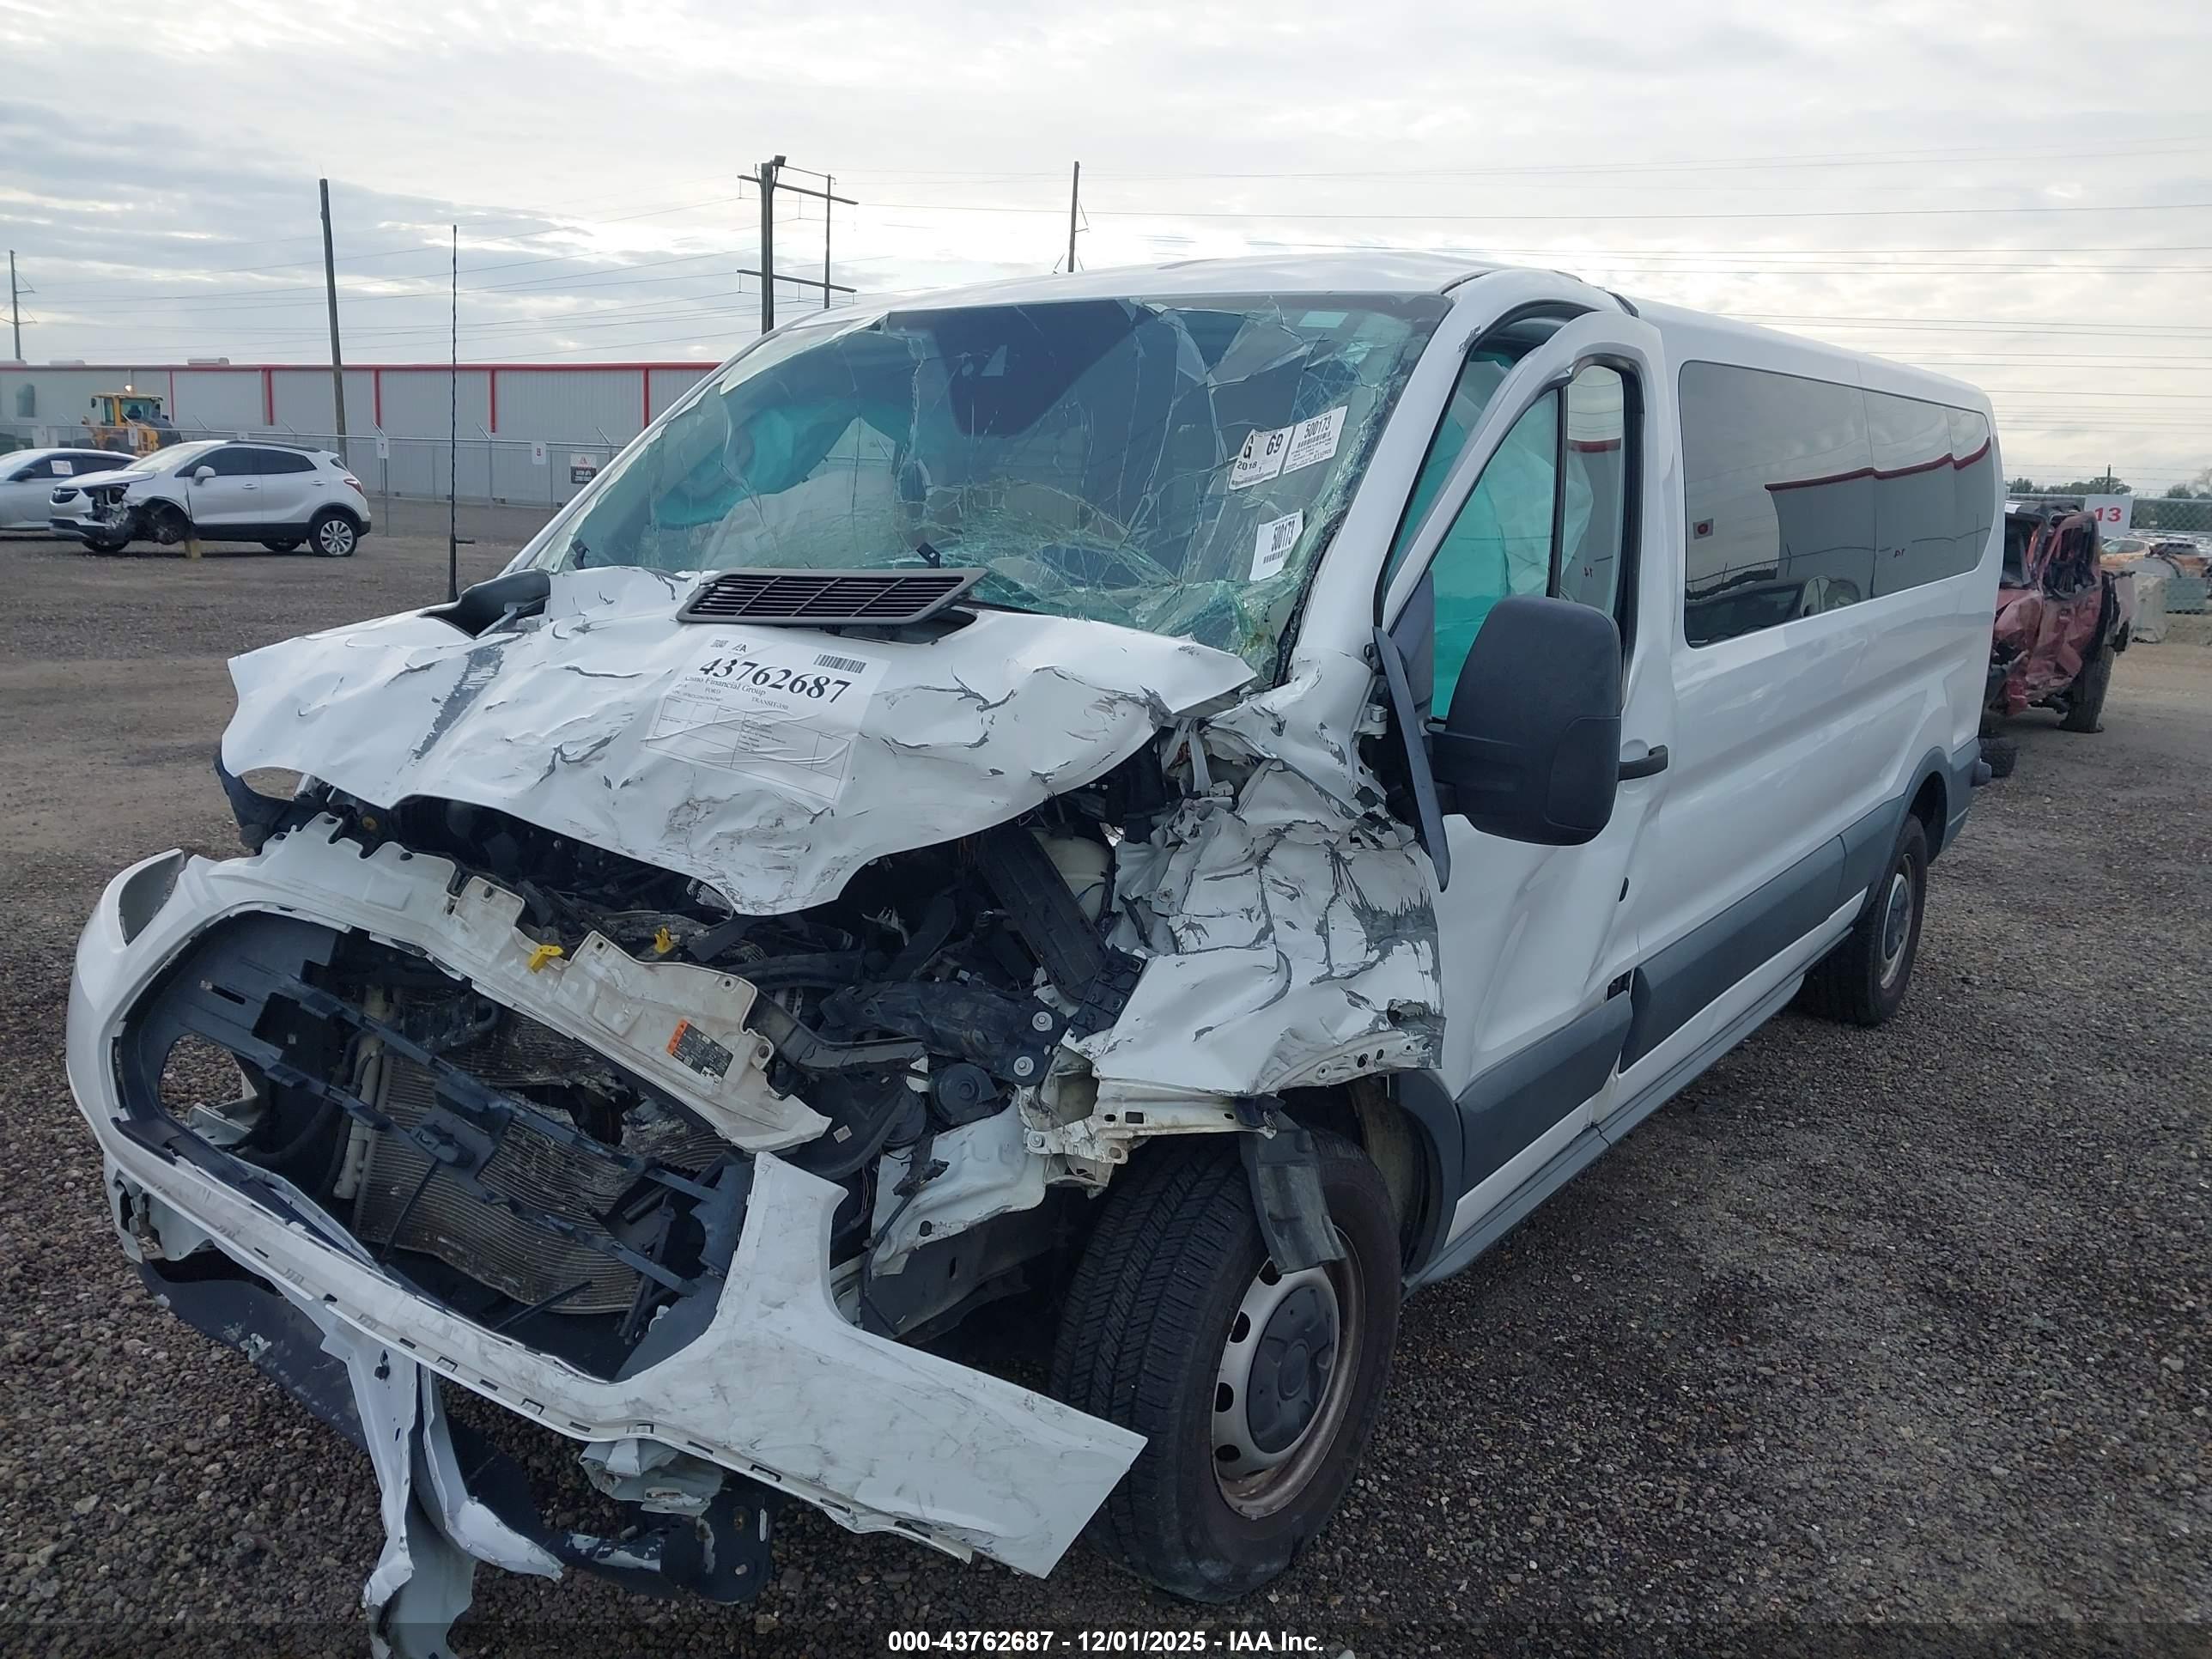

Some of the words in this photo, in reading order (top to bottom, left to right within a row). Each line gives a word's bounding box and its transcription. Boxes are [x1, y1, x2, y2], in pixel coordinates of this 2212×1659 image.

[1304, 415, 1332, 439] 500173
[1266, 433, 1284, 456] 69
[1237, 460, 1258, 471] 2018
[2094, 507, 2122, 522] 13
[1271, 520, 1295, 552] 500173
[698, 658, 852, 704] 43762687
[705, 677, 742, 691] Financial
[742, 684, 767, 697] Group
